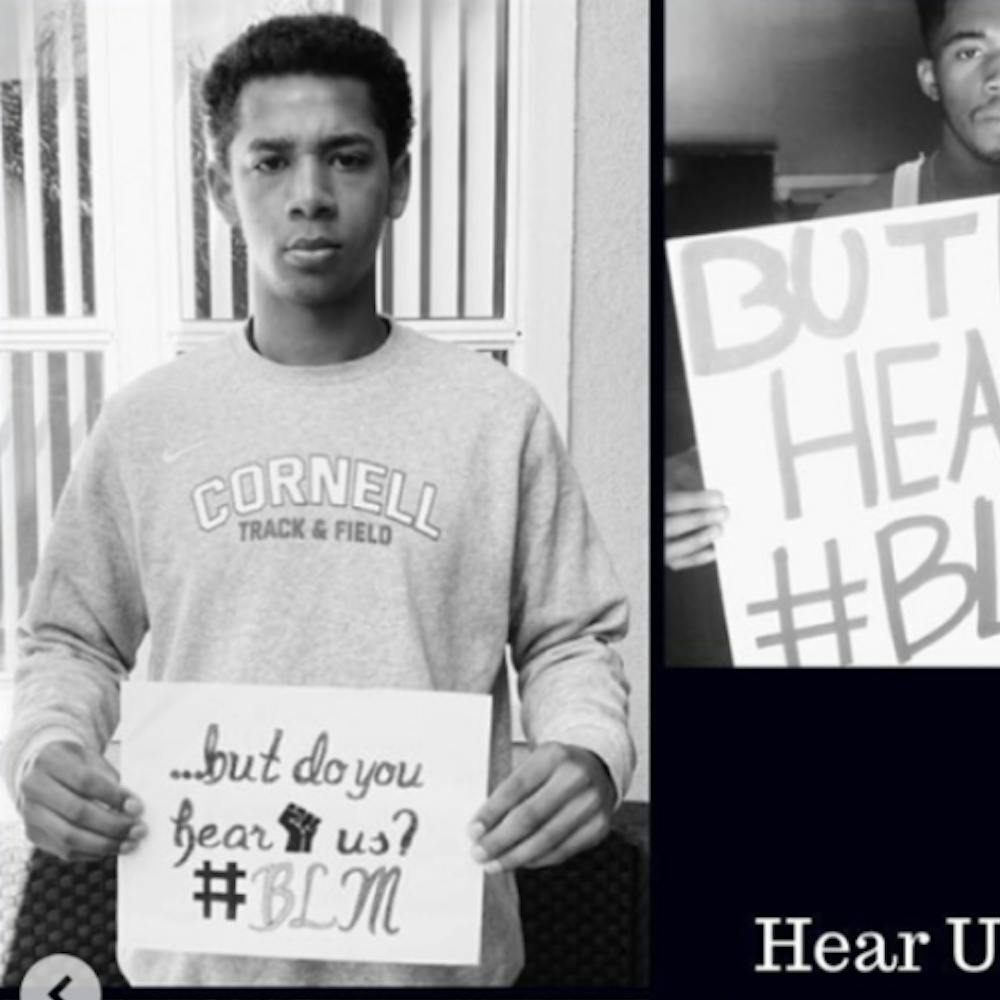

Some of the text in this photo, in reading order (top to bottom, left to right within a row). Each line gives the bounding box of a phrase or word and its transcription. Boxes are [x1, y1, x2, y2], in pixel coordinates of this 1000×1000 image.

[680, 212, 979, 377] BUT
[192, 453, 442, 541] CORNELL
[238, 518, 393, 545] TRACK & FIELD
[292, 731, 348, 786] do
[345, 758, 424, 800] you
[170, 797, 420, 868] hear us?
[193, 858, 403, 935] #BLM
